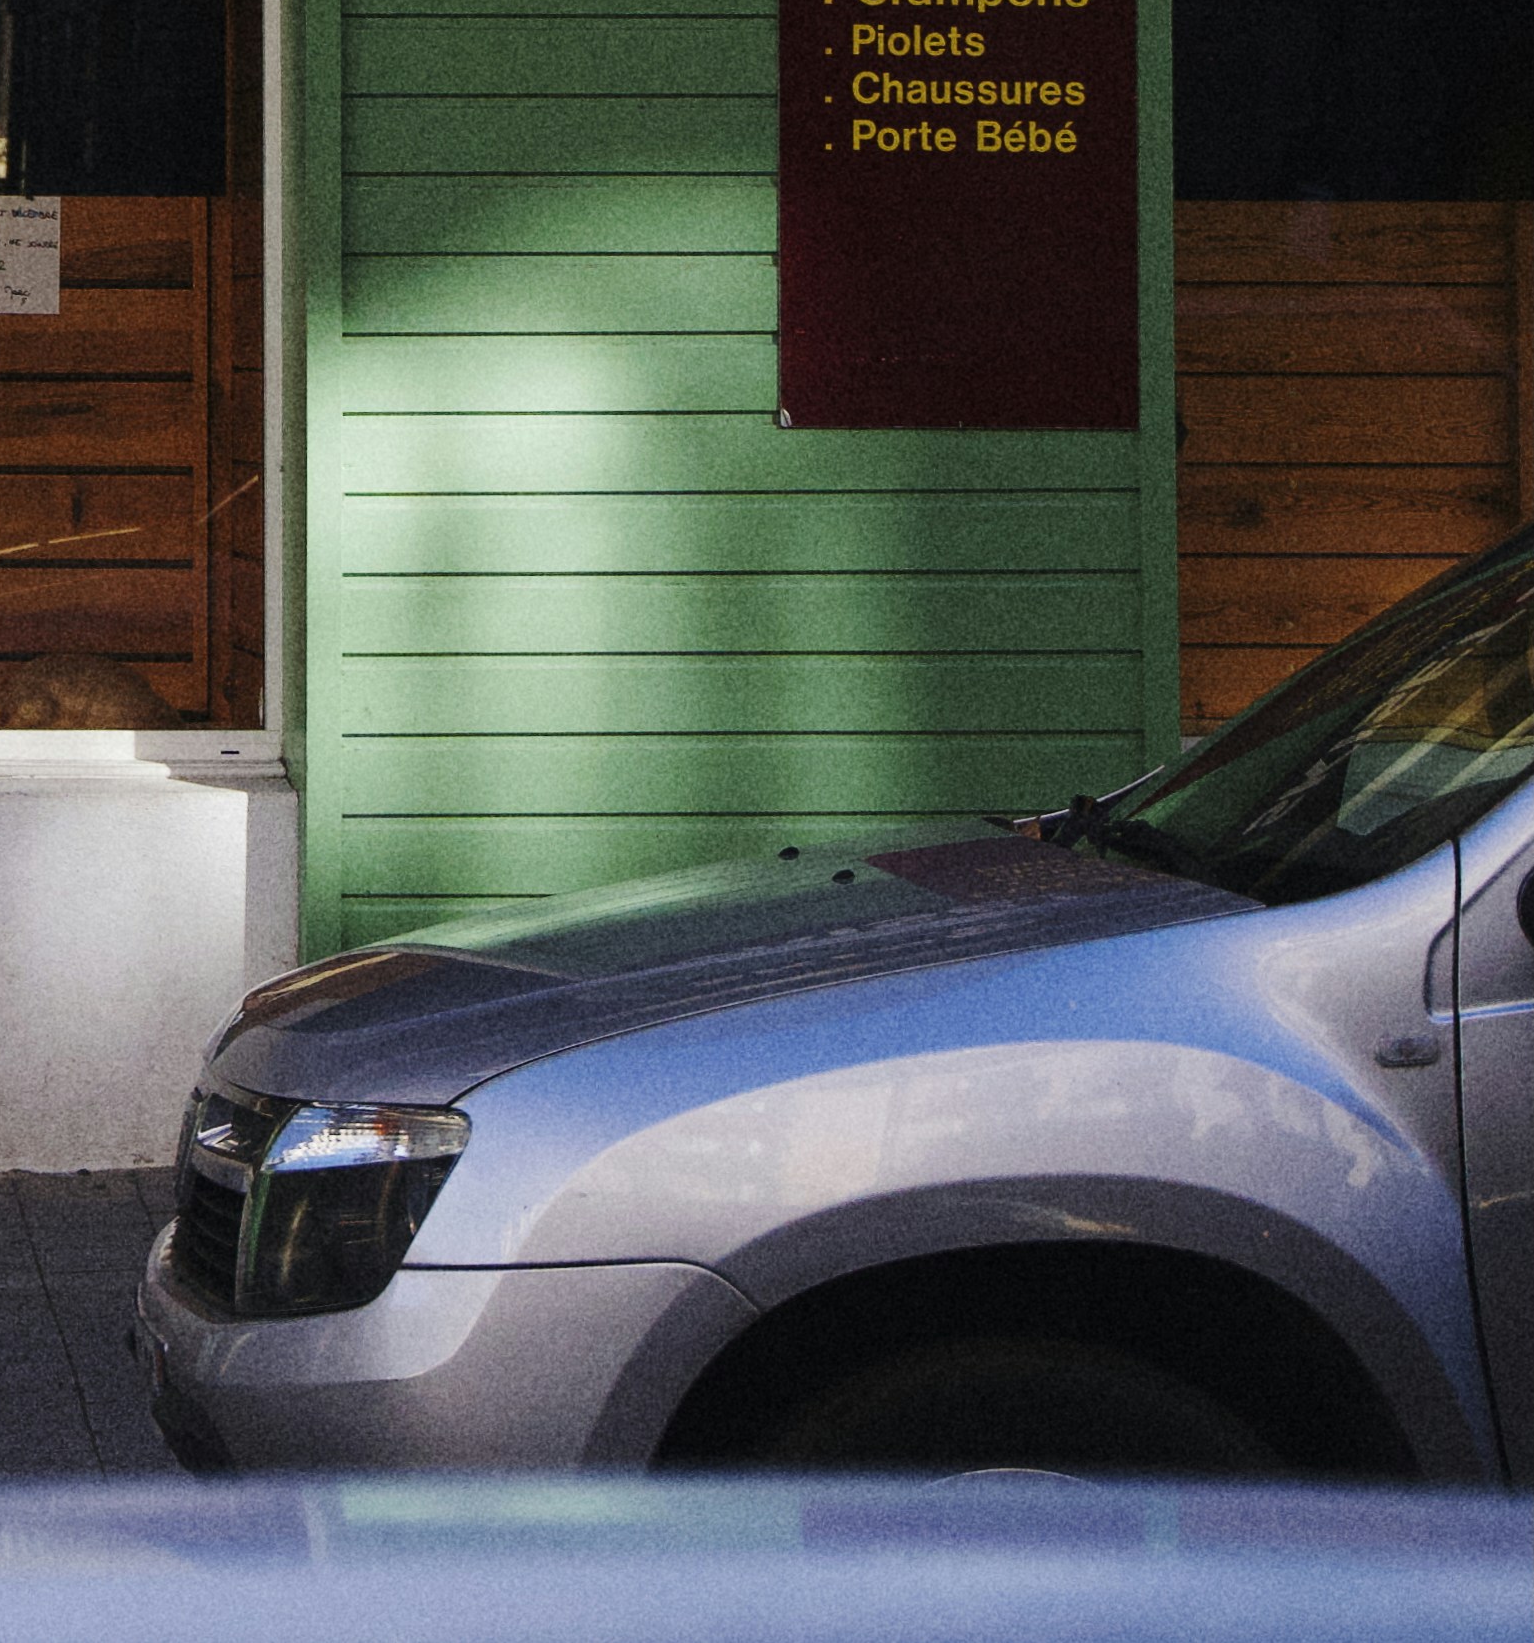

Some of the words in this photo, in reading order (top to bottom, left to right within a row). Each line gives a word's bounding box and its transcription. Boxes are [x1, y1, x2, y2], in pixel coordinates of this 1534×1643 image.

[851, 23, 987, 59] Piolets
[851, 71, 1087, 108] Chaussures
[851, 120, 958, 154] Porte
[976, 118, 1078, 154] Bébé
